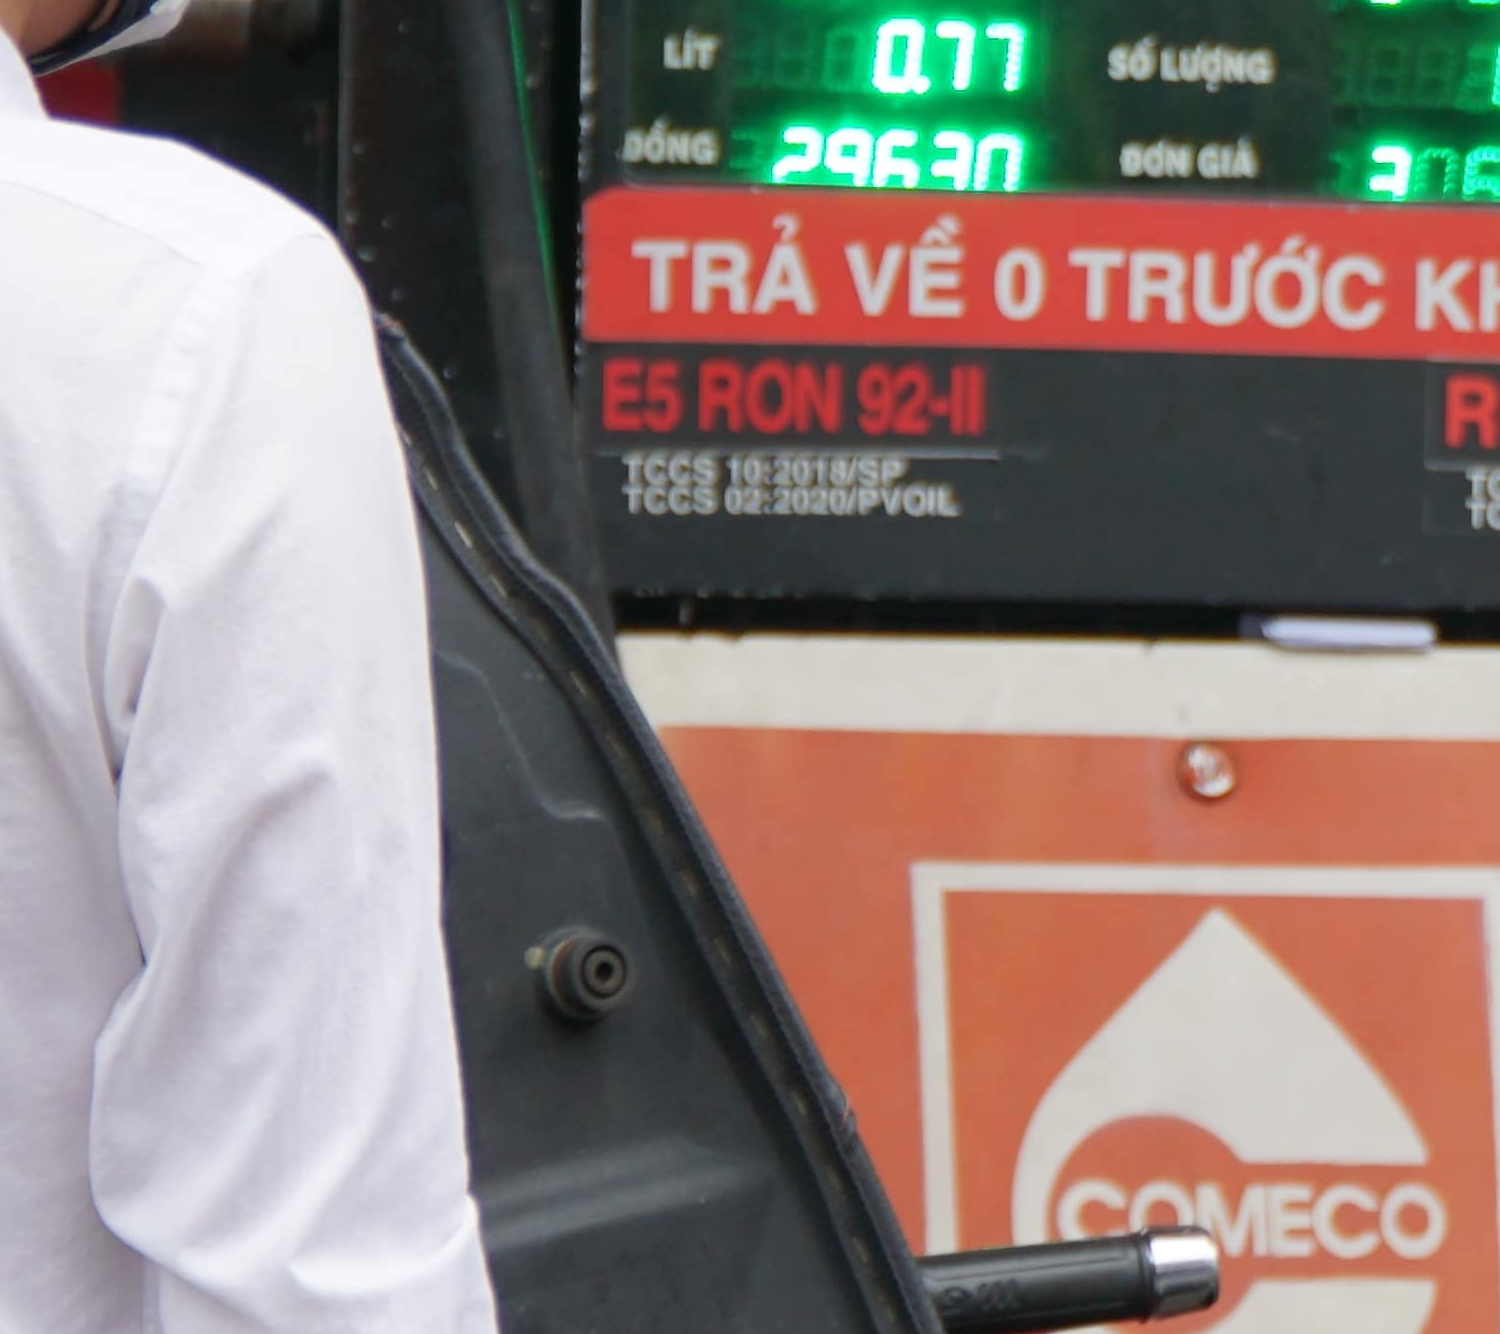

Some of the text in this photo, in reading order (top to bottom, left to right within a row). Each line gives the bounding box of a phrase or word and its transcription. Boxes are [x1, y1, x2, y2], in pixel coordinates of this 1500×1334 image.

[662, 24, 721, 71] LÍT
[871, 17, 1026, 95] 0.77
[631, 215, 816, 317] TRẢ
[846, 226, 965, 320] VỀ
[995, 255, 1045, 322] 0
[1069, 236, 1382, 331] TRƯỚC
[602, 359, 986, 437] E5 RON 92-II
[622, 452, 720, 487] TCCS
[622, 483, 961, 519] TCCS 02:2020/PVOIL
[1056, 1178, 1446, 1260] COMECO
